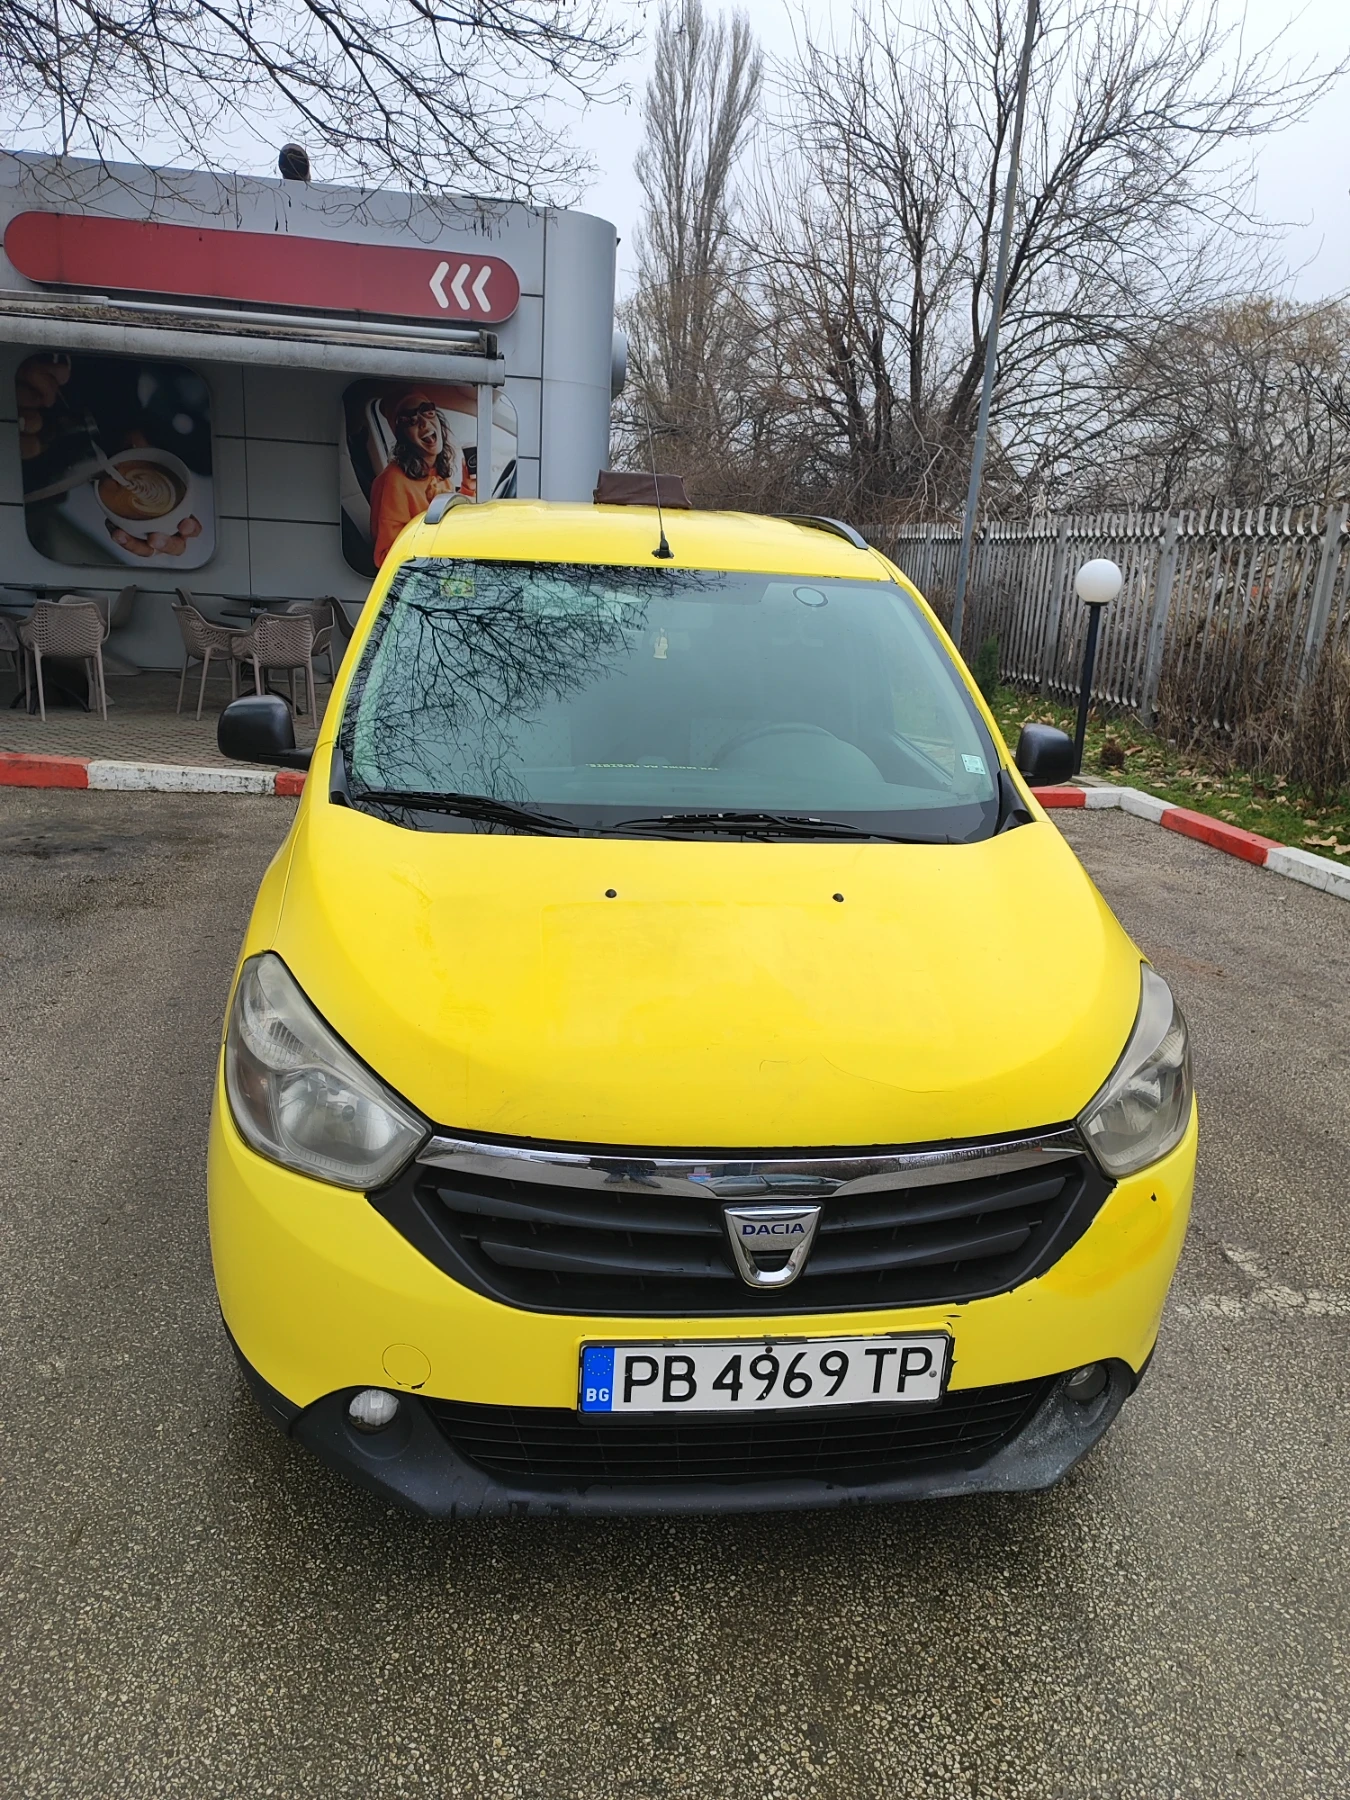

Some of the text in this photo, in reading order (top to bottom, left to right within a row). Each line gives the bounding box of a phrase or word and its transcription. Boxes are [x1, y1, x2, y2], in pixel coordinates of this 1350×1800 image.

[742, 1223, 805, 1235] DACIA
[623, 1346, 933, 1403] PB 4969 TP
[585, 1388, 610, 1402] BG
